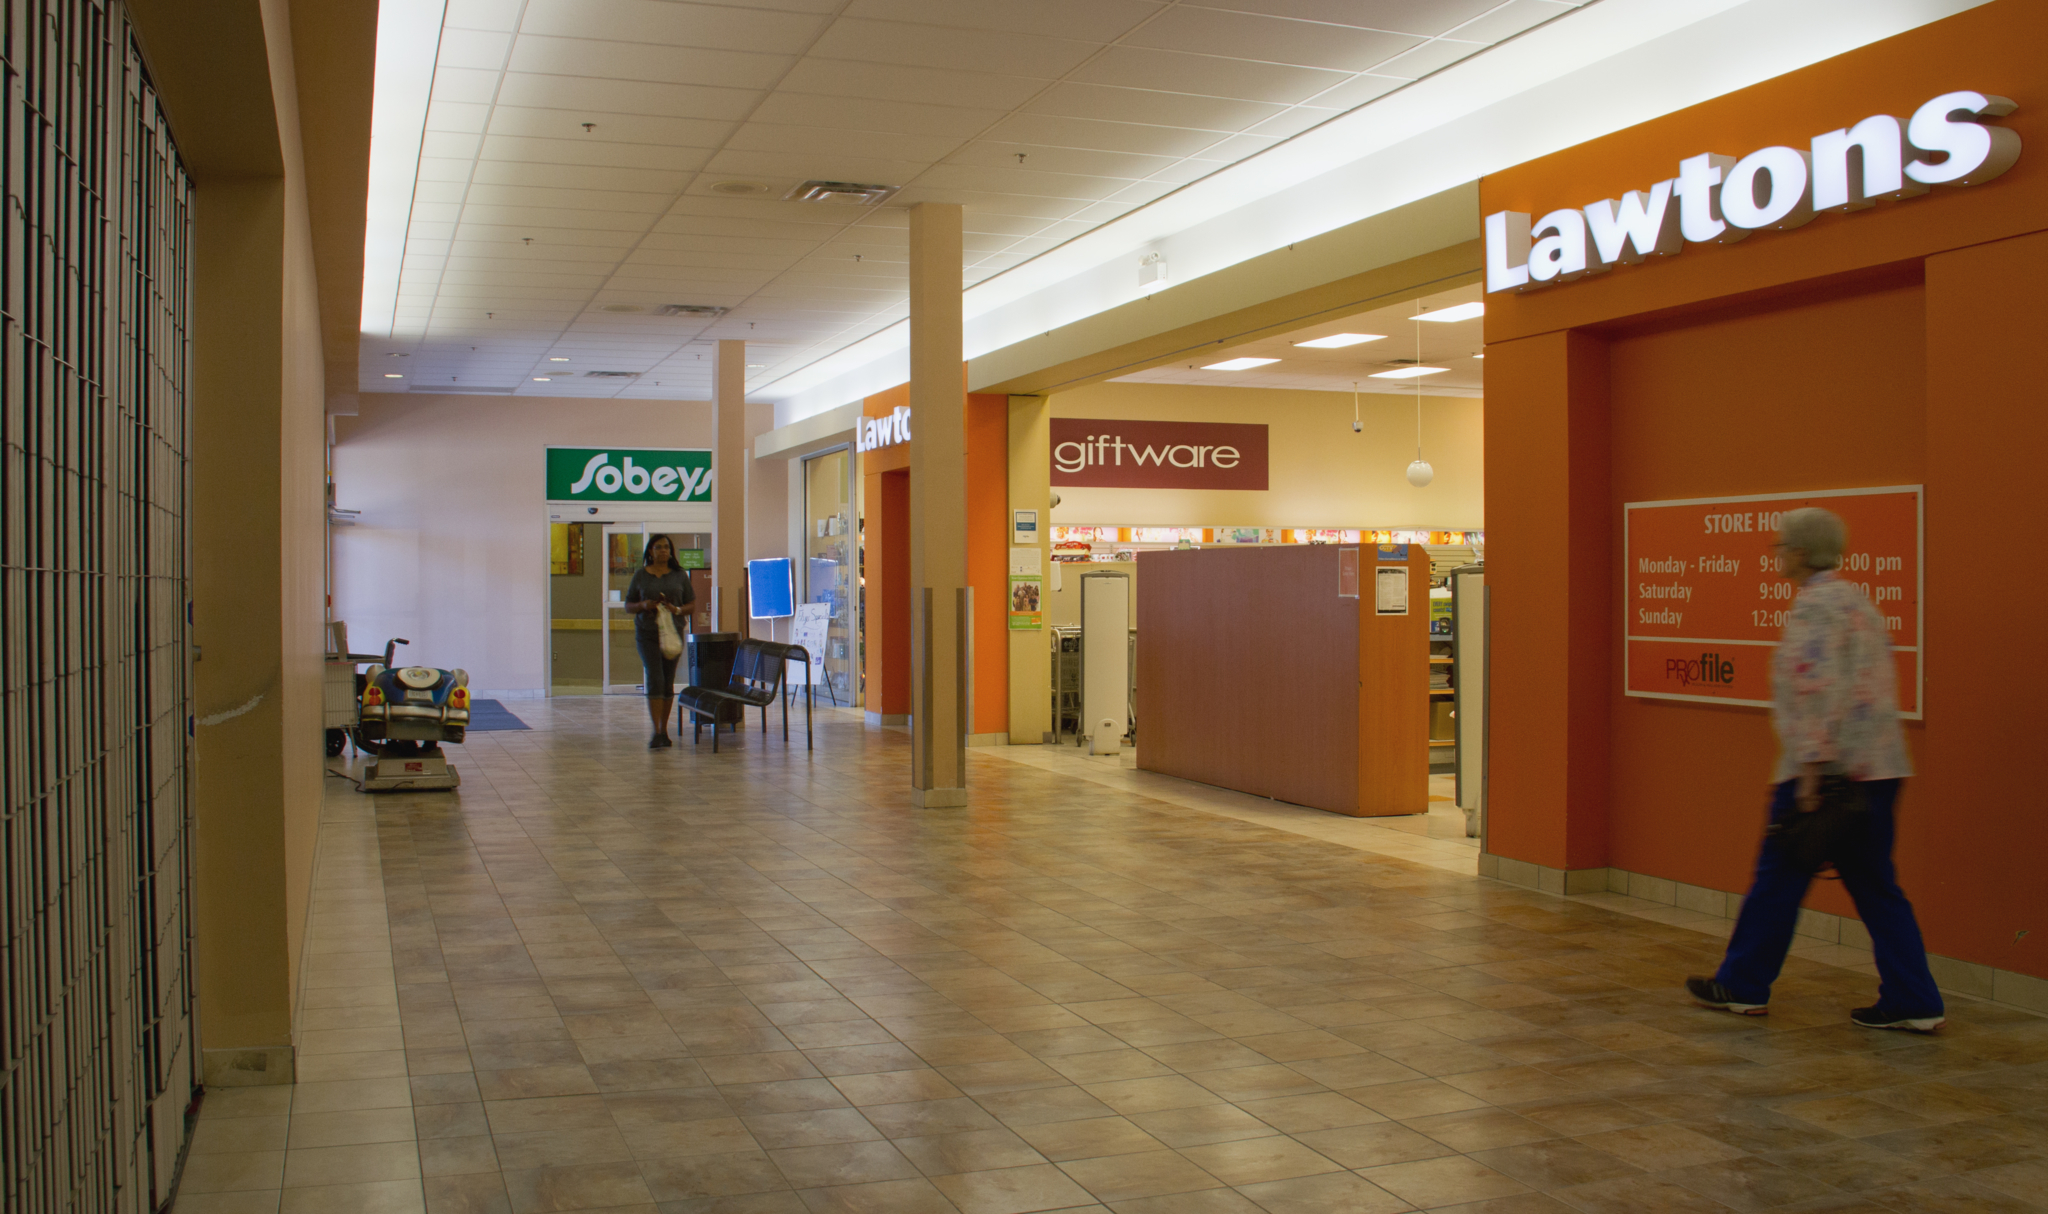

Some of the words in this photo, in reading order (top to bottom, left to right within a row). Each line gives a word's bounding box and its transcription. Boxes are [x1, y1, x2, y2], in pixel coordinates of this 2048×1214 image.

[1485, 91, 2000, 295] Lawtons
[856, 406, 911, 453] Lawto
[1054, 434, 1241, 473] giftware
[571, 453, 713, 501] Sobeys
[1704, 512, 1753, 534] STORE
[1638, 555, 1687, 577] Monday
[1698, 554, 1740, 577] Friday
[1759, 555, 1783, 572] 9:0
[1875, 556, 1902, 575] pm
[1638, 581, 1692, 603] Saturday
[1759, 582, 1792, 600] 9:00
[1875, 585, 1902, 605] pm
[1638, 607, 1683, 629] Sunday
[1751, 610, 1791, 627] 12:00
